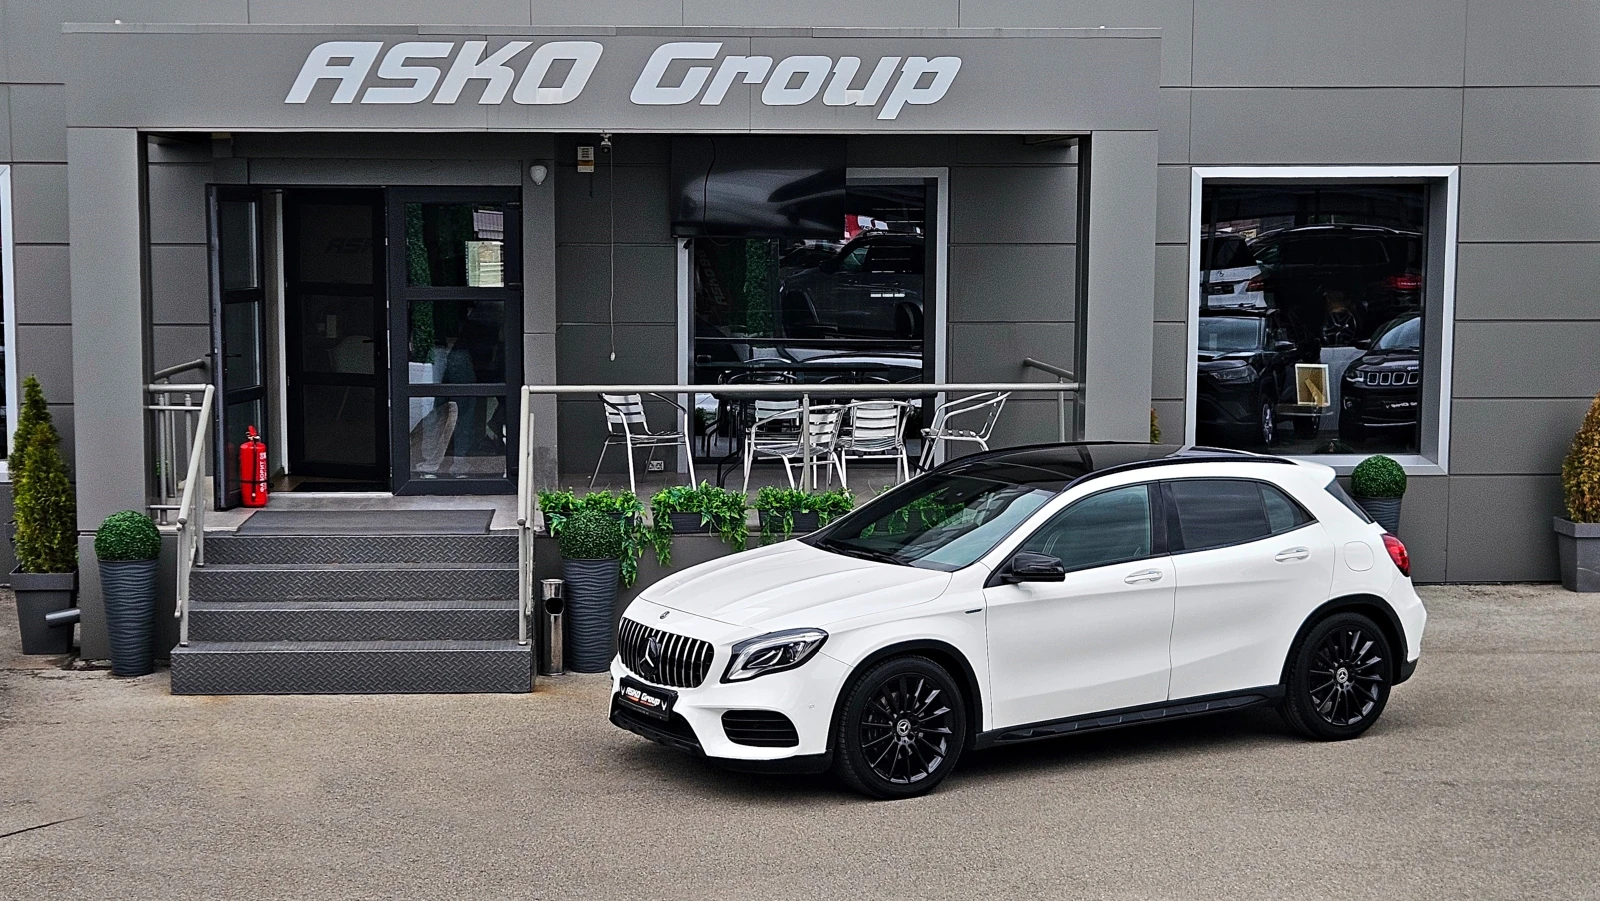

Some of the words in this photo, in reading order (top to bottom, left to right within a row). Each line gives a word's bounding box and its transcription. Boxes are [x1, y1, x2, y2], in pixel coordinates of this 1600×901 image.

[284, 40, 604, 105] ASKO
[630, 42, 962, 120] Group
[625, 687, 642, 699] ASKO
[641, 692, 661, 706] Group
